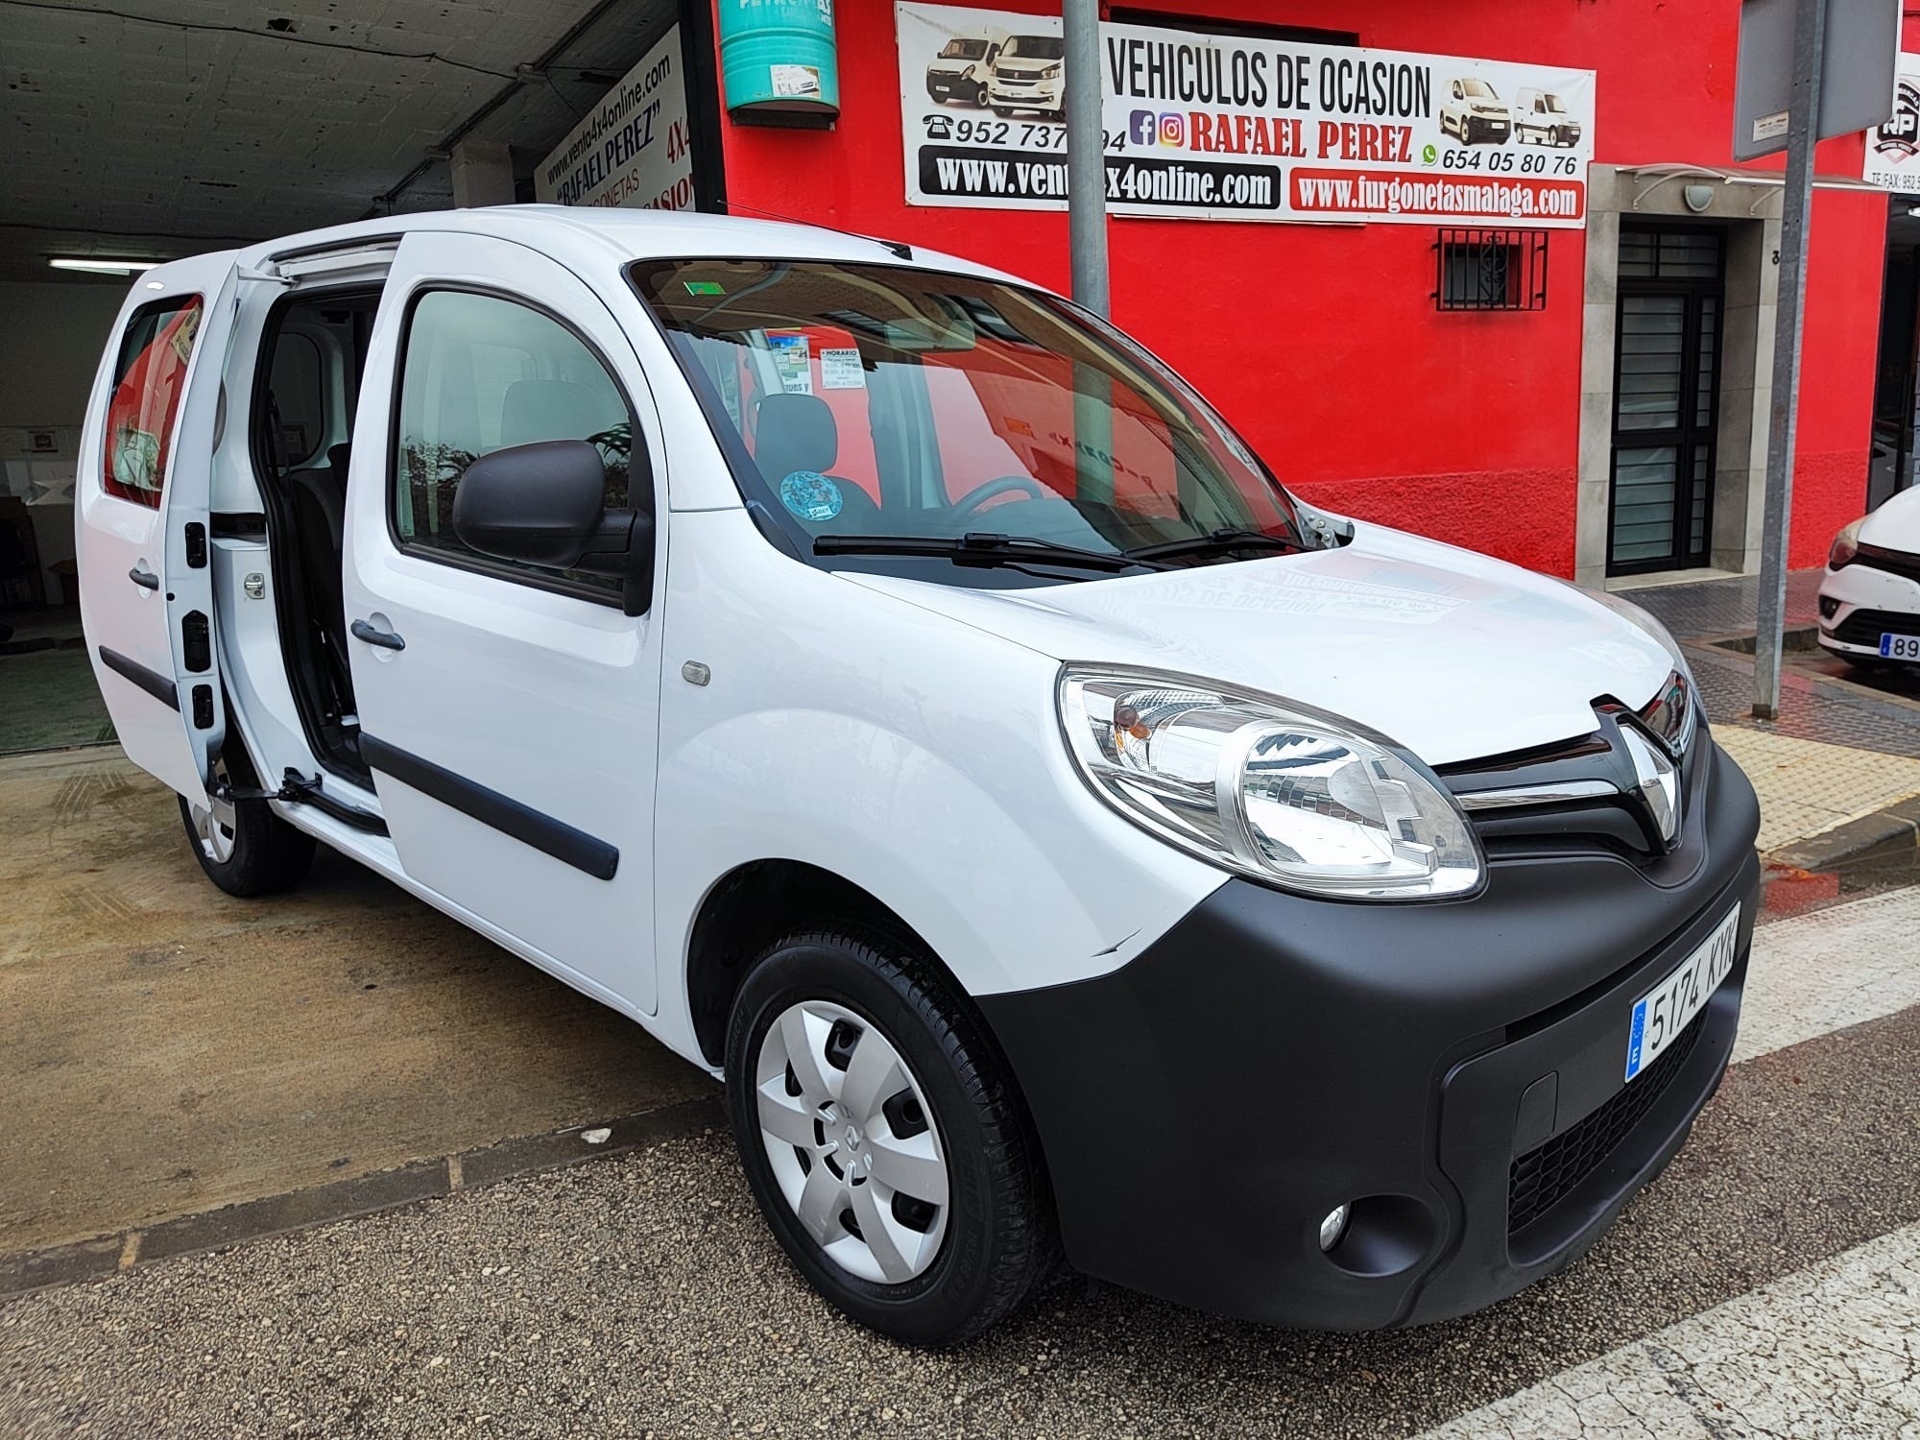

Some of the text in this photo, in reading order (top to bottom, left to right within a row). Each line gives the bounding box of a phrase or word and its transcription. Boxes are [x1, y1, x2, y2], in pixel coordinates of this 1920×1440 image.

[1107, 37, 1430, 118] VEHICULOS DE OCASION
[956, 119, 1010, 145] 952
[1189, 111, 1412, 163] RAFAEL PEREZ
[1443, 149, 1577, 175] 654 05 80 76
[1299, 175, 1576, 217] www.furgonetasmalaga.com
[1894, 638, 1920, 658] 89
[1651, 914, 1738, 1050] 5174 KYK
[1631, 1045, 1639, 1063] E
